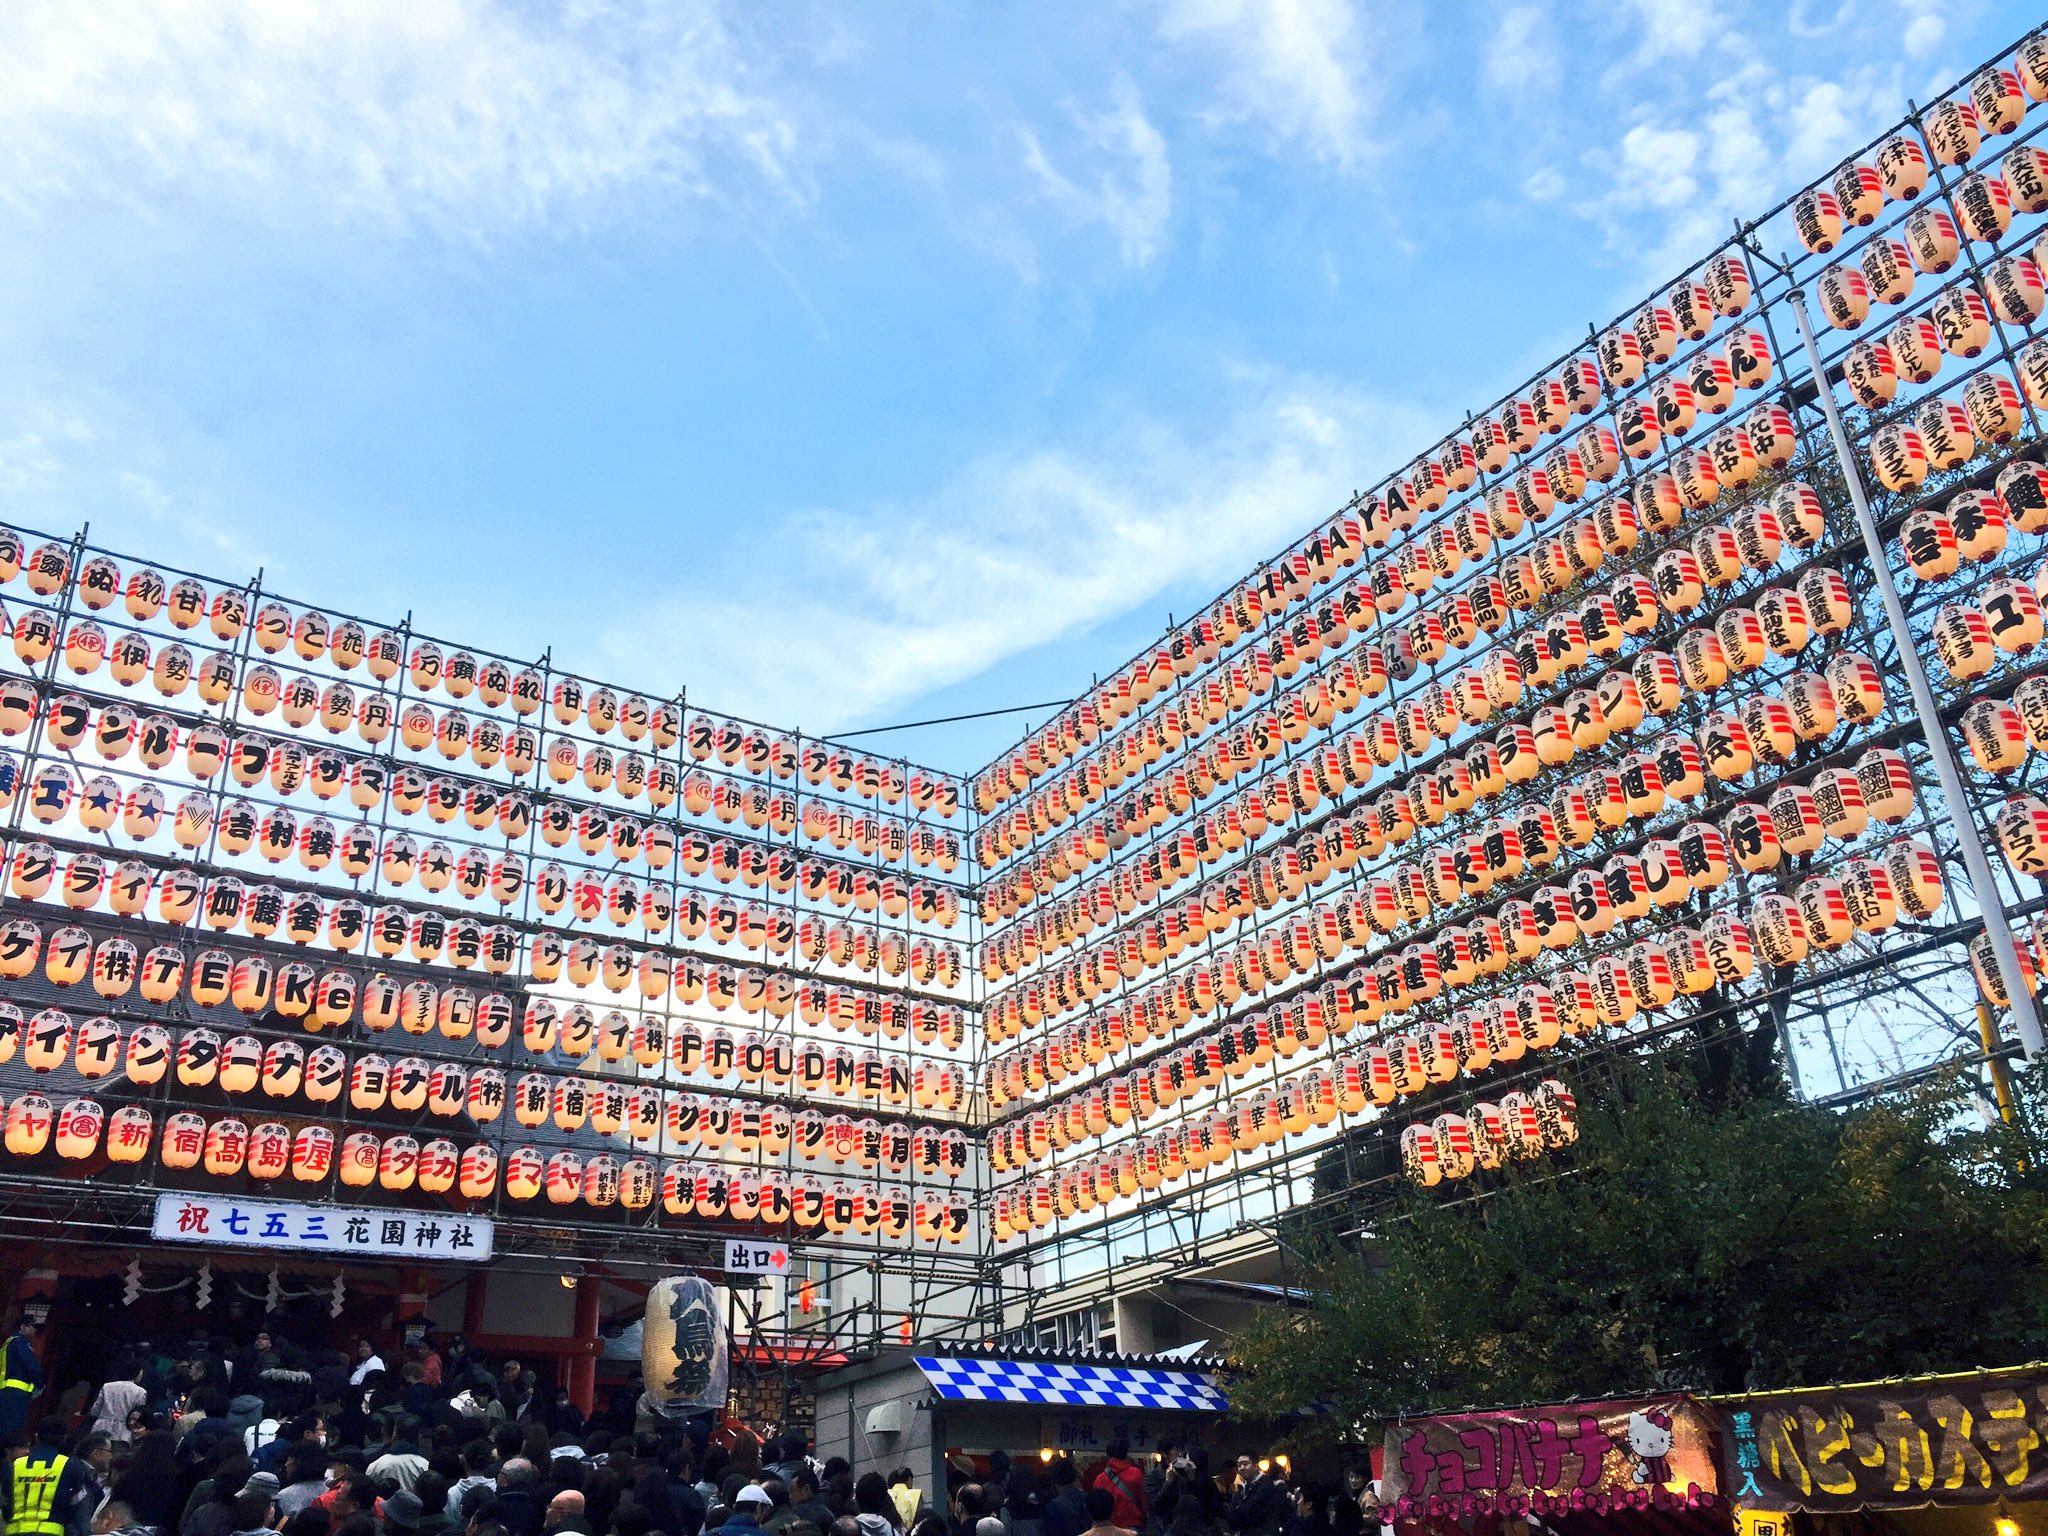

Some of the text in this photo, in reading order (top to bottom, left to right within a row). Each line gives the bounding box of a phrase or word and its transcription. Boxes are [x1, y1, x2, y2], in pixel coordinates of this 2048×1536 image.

[1856, 871, 1882, 918] 東京メトロ
[8, 922, 35, 933] 奉納
[63, 928, 90, 942] 奉納
[107, 940, 135, 951] 奉納
[157, 948, 185, 959] 奉納
[204, 951, 231, 962] 奉納
[1680, 942, 1697, 973] 株式会社
[1709, 940, 1740, 979] ATOM
[1590, 984, 1605, 1012] BAR
[41, 1013, 68, 1024] 奉納
[93, 1020, 118, 1031] 奉納
[137, 1028, 167, 1039] 奉納
[193, 1029, 219, 1041] 奉納
[22, 1097, 50, 1109] 奉納
[74, 1102, 101, 1114] 奉納
[124, 1109, 150, 1120] 奉納
[177, 1114, 203, 1126] 奉納
[218, 1121, 246, 1133] 奉納
[176, 1202, 475, 1250] 祝 七五三 花園神社
[731, 1244, 771, 1269] 出口
[1759, 1384, 2048, 1497] ベビーカステ
[1399, 1415, 1614, 1497] チョコバナナ
[1732, 1411, 1764, 1497] 黒糖入
